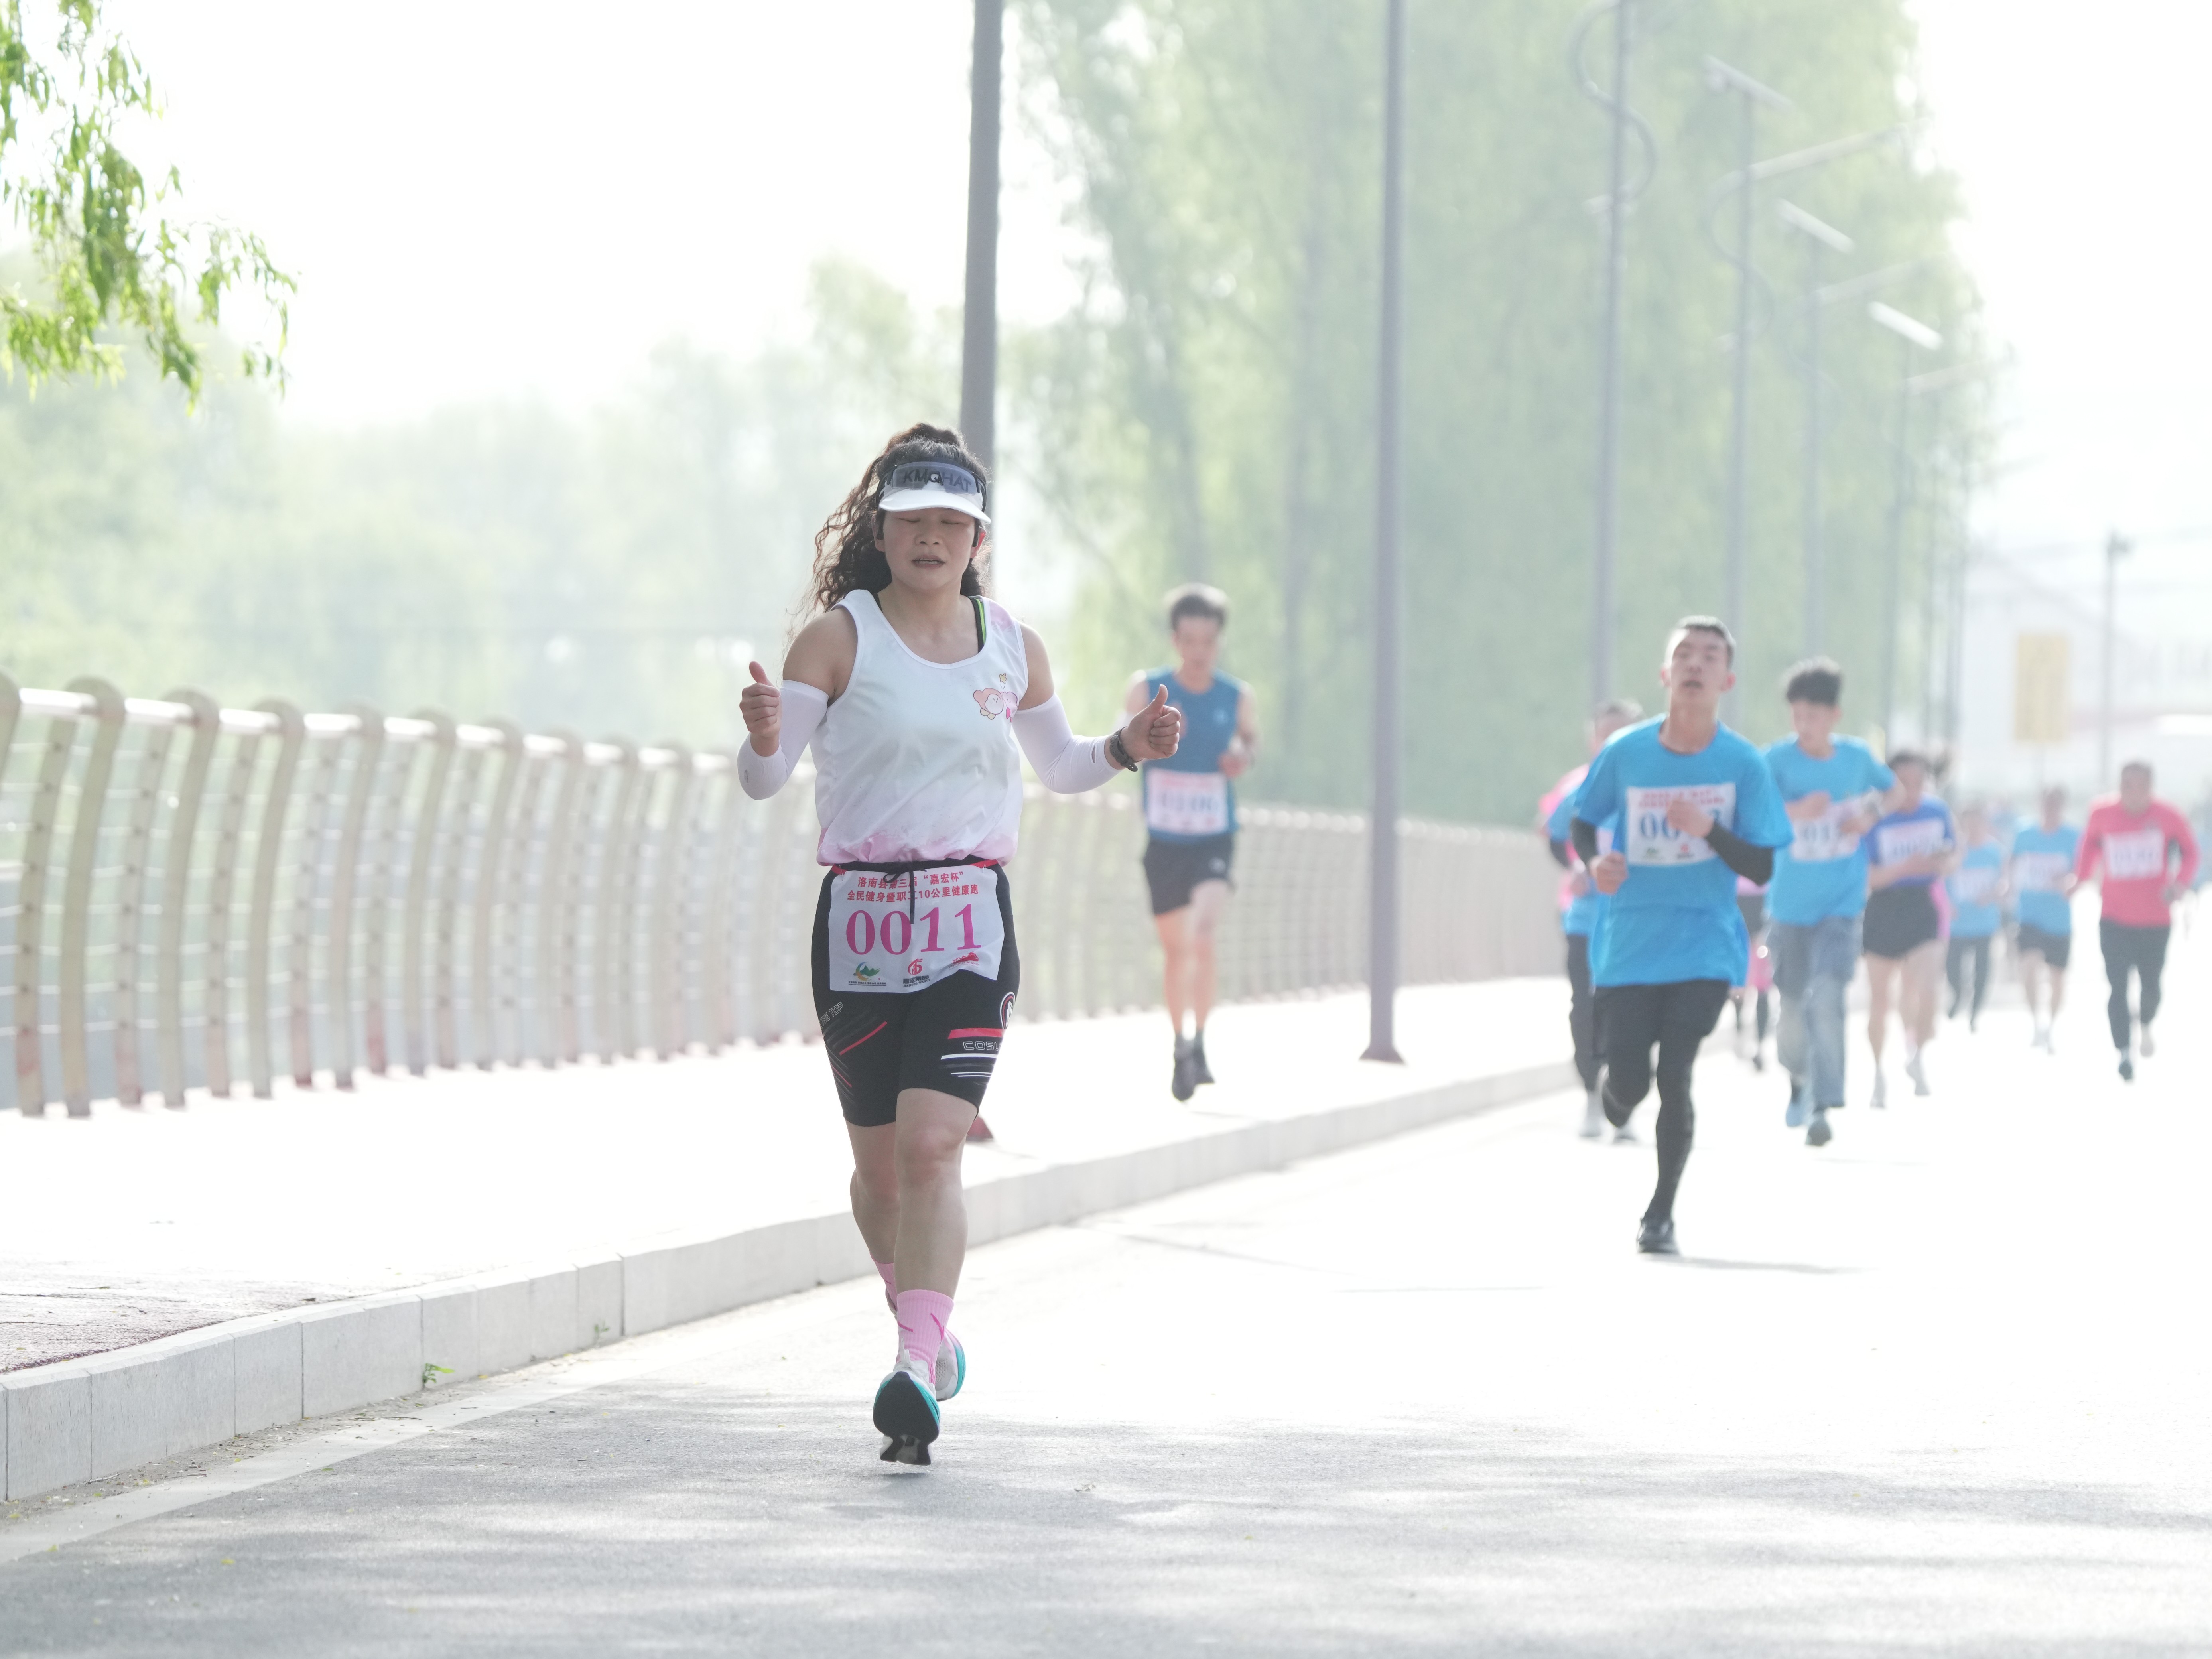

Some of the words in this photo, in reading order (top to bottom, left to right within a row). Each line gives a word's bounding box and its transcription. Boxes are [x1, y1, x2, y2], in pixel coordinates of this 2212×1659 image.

[846, 904, 981, 955] 0011
[820, 1012, 831, 1026] THE
[829, 1001, 843, 1017] TOP
